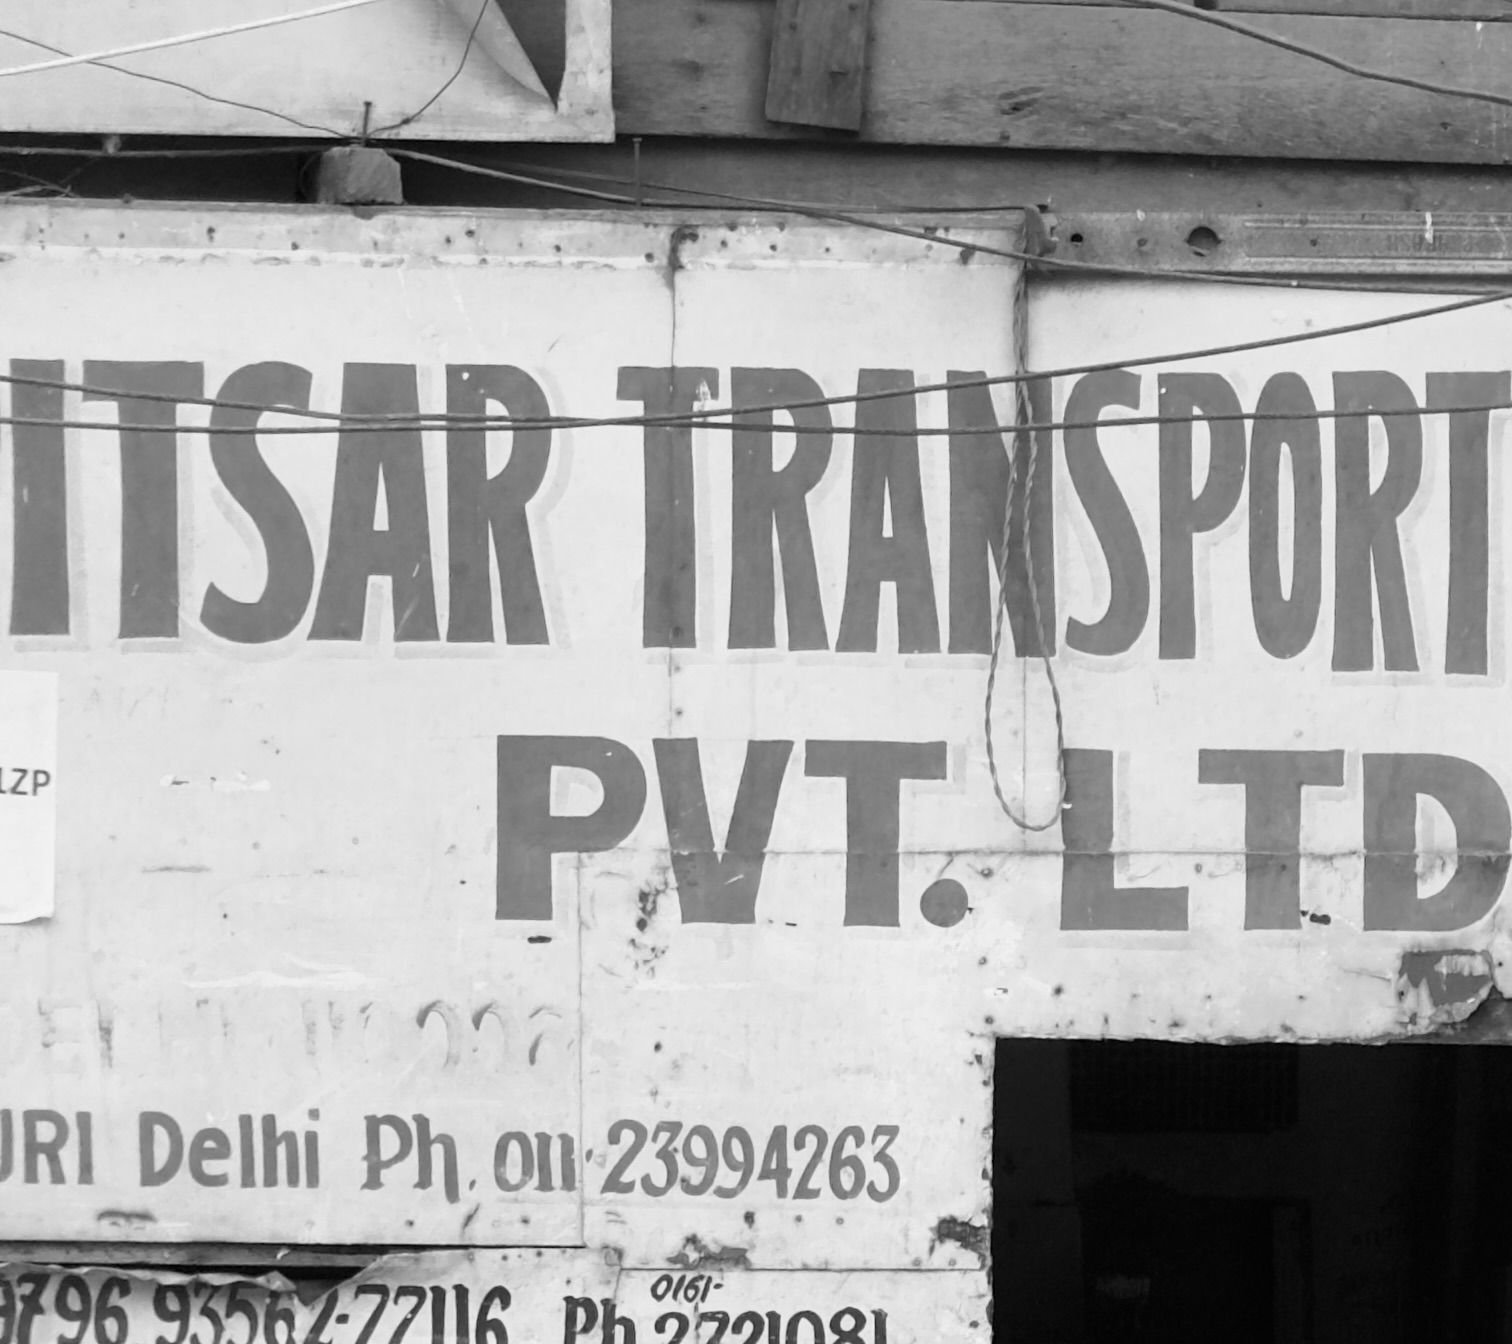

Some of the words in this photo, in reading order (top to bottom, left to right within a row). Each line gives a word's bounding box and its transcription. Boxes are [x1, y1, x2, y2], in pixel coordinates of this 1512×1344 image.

[616, 366, 1512, 676] TRANSPORT
[496, 735, 969, 930] PVT.
[139, 1107, 320, 1188] Delhi
